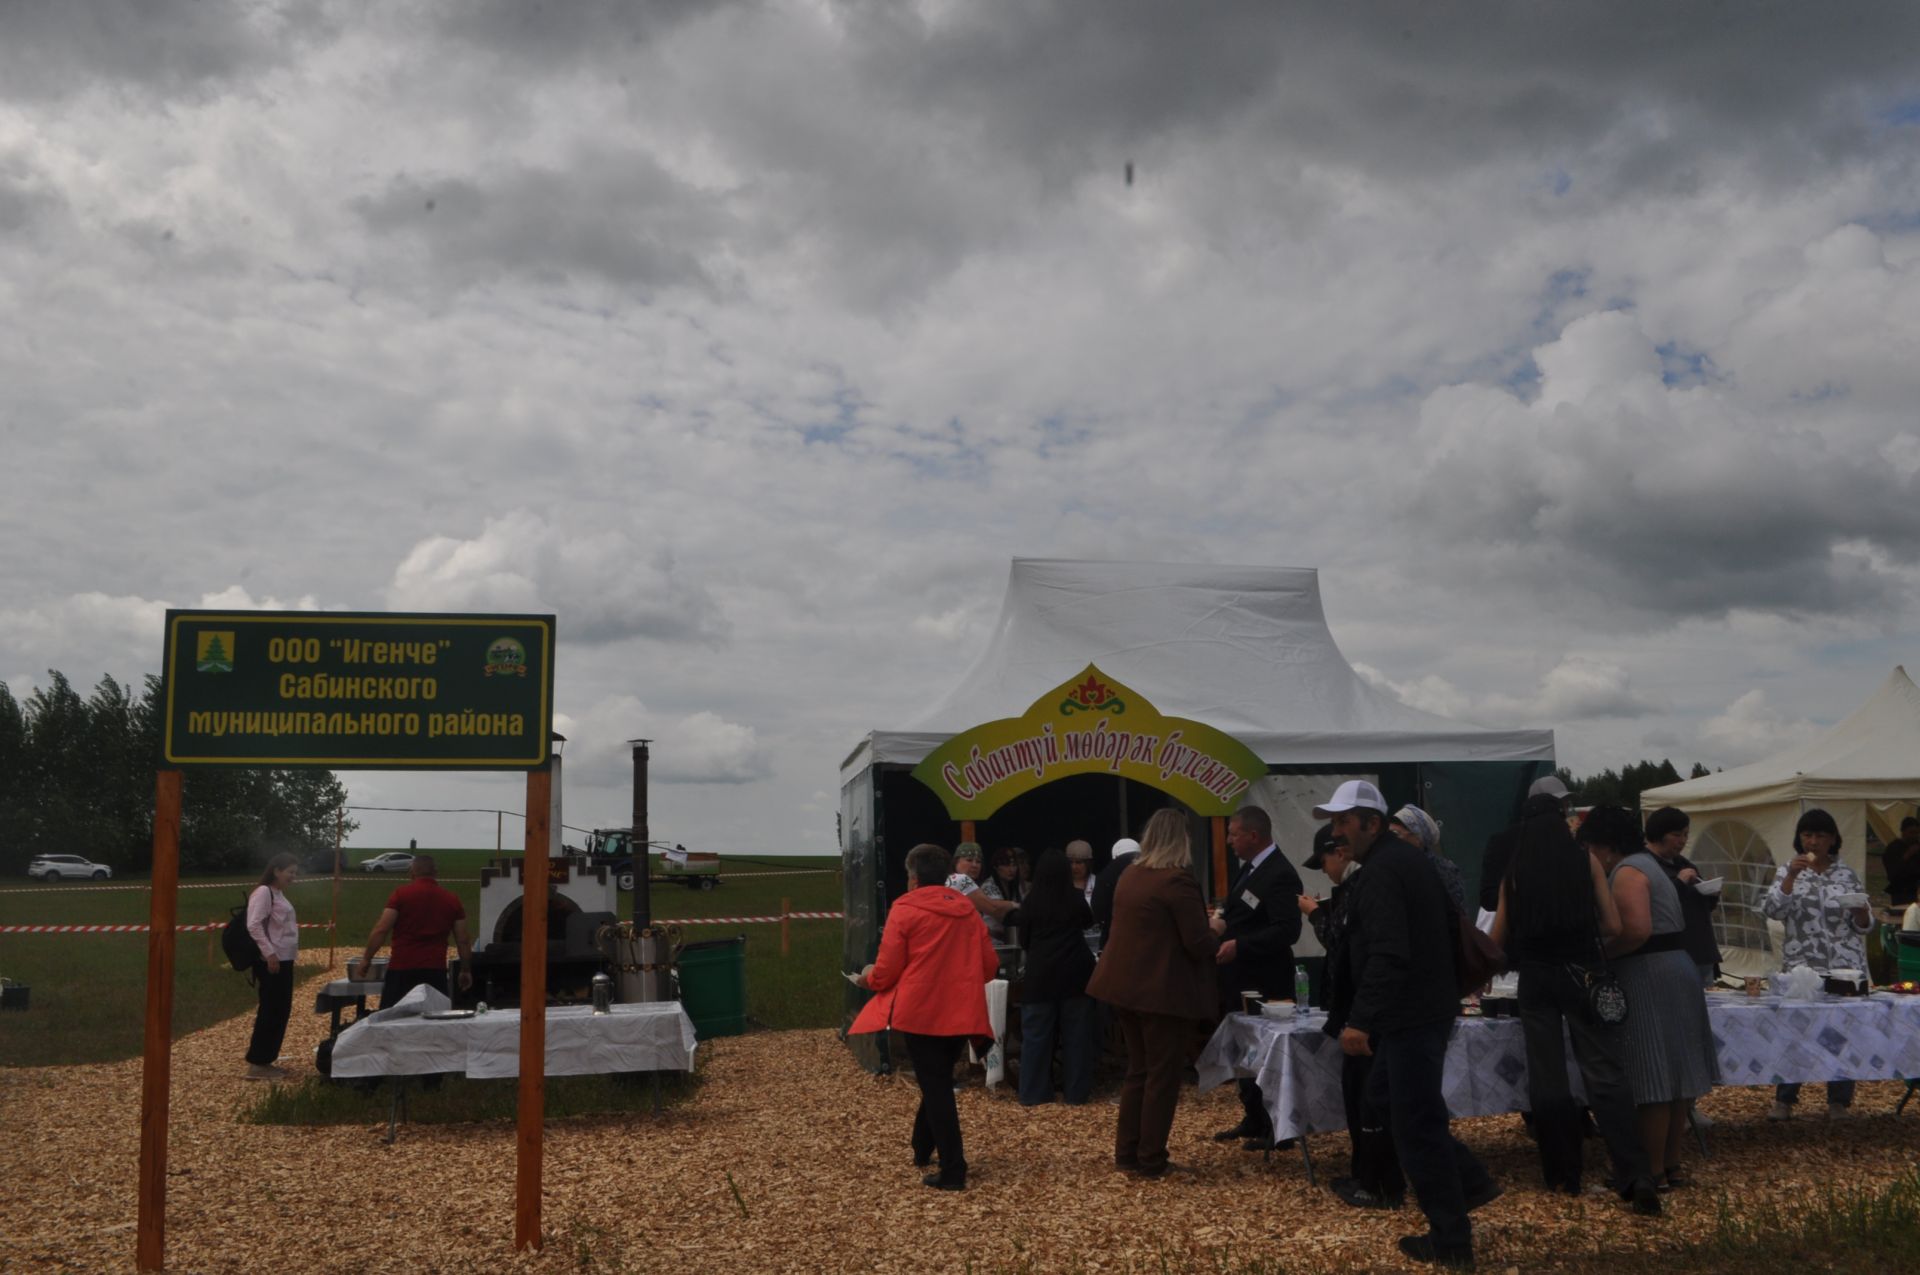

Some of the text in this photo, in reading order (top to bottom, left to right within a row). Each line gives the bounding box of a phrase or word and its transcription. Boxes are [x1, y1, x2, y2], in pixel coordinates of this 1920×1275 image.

[268, 637, 321, 664] ООО
[279, 672, 438, 701] Сабинского
[188, 708, 524, 738] муниципального района
[942, 717, 1249, 804] Сабантуй мөбәрәк булсын!
